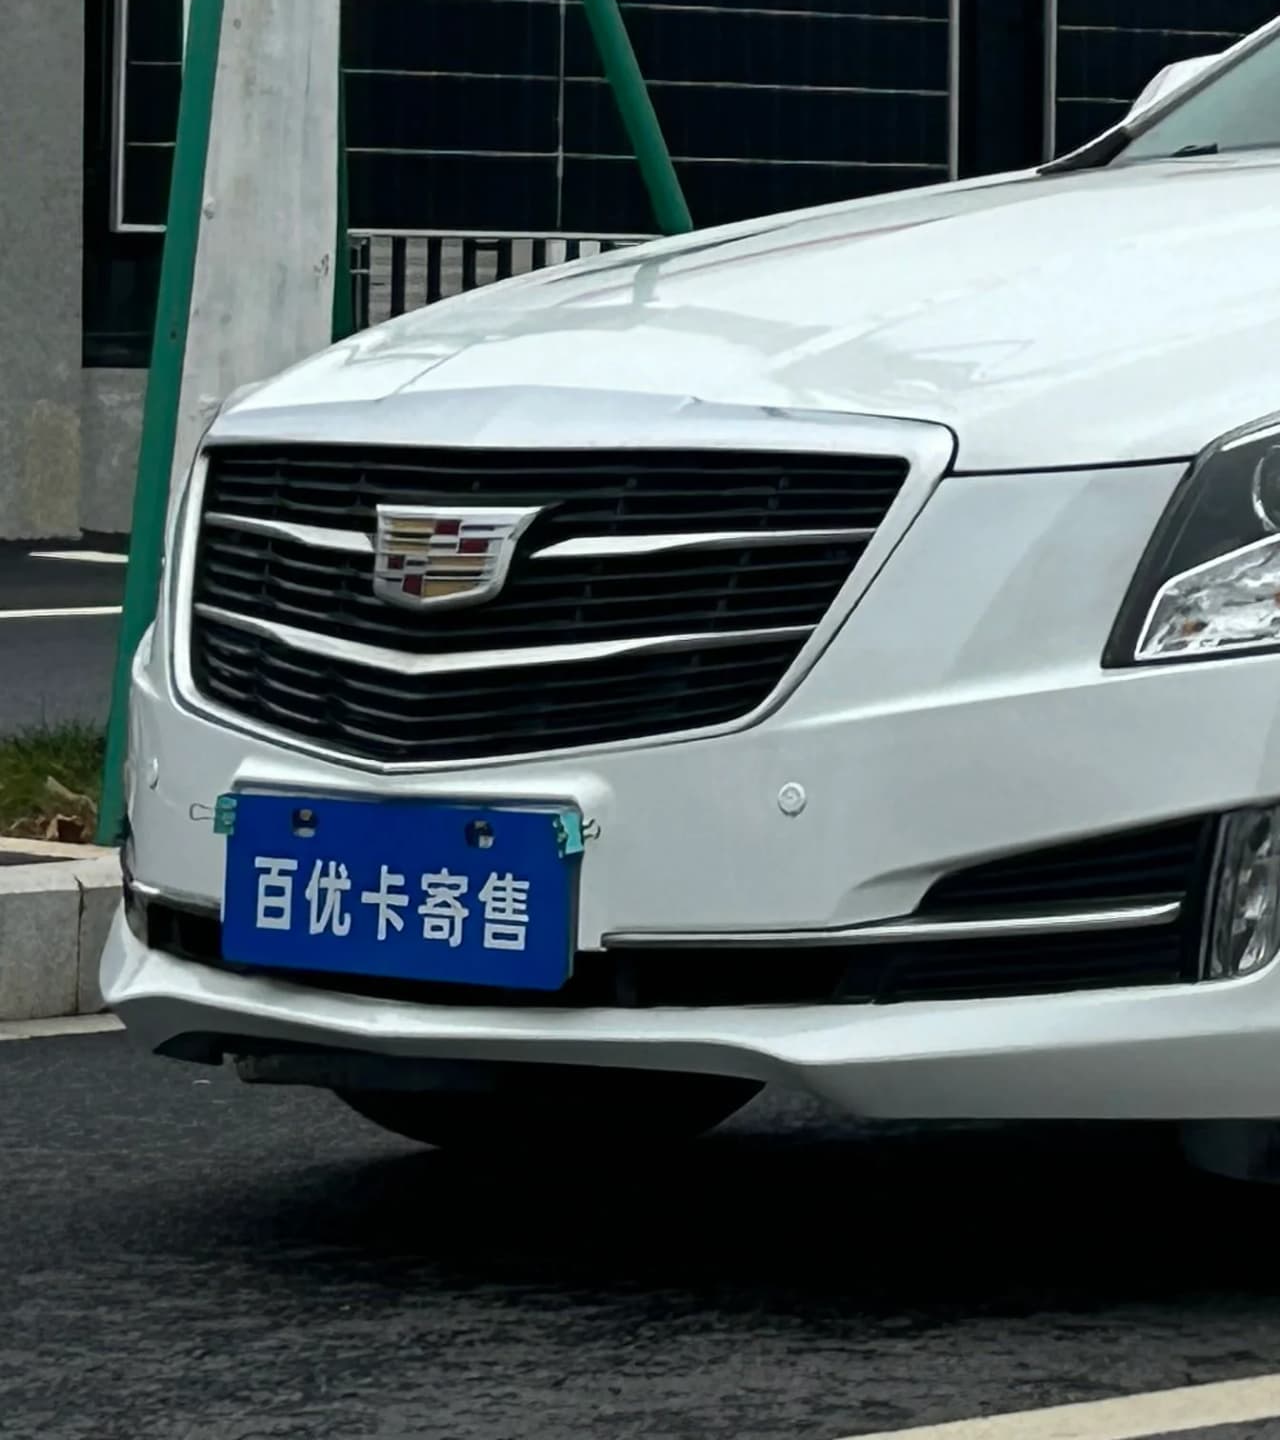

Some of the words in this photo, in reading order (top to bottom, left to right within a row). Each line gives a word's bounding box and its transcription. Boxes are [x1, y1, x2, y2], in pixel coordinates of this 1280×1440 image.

[254, 856, 530, 951] 百优卡寄售
